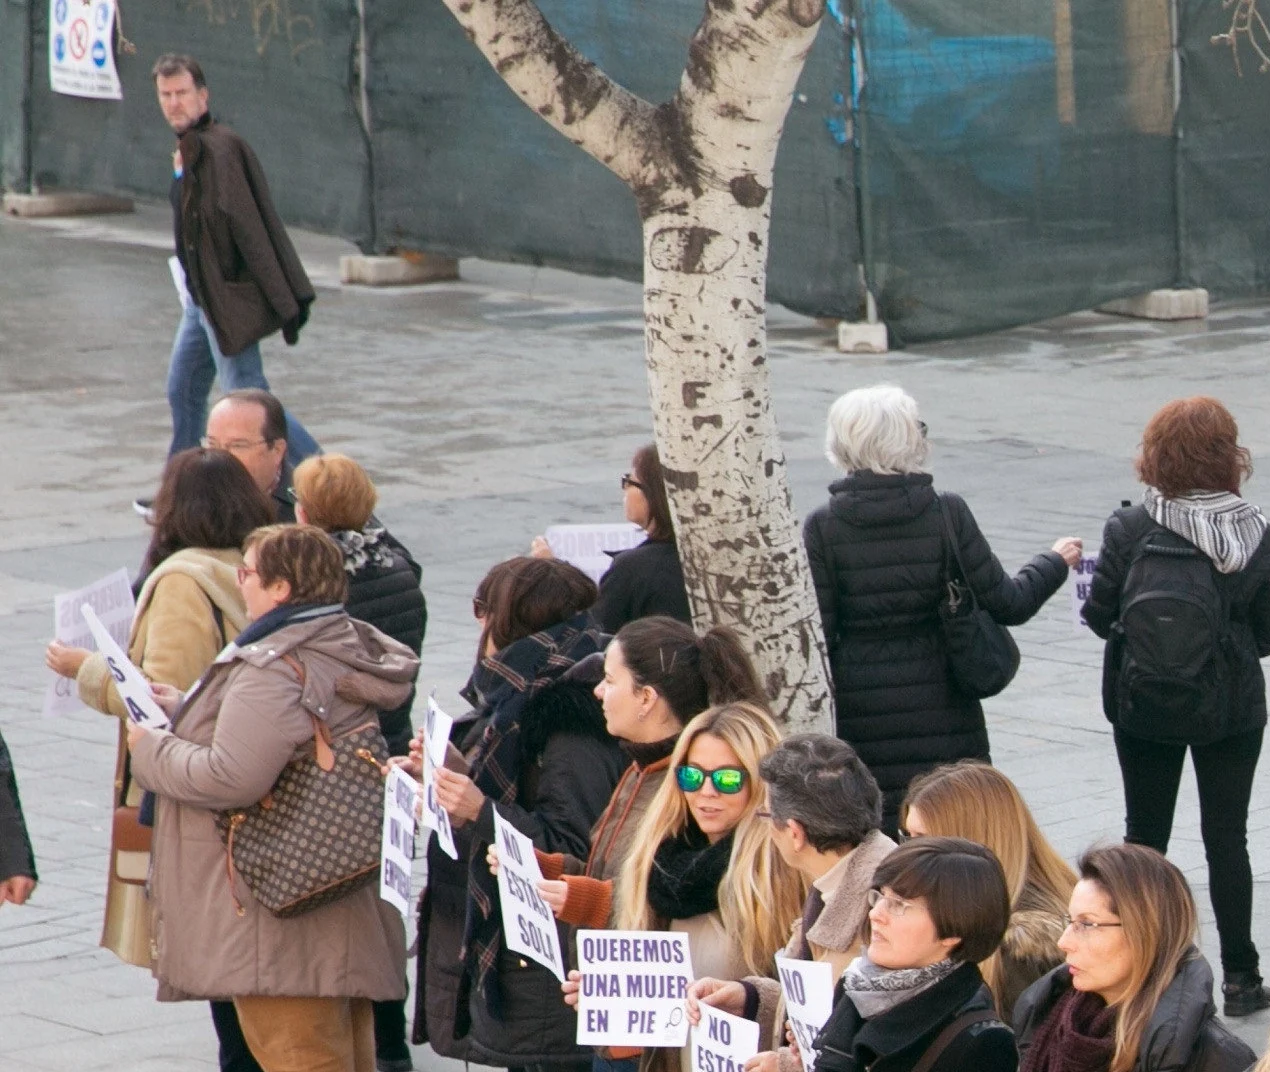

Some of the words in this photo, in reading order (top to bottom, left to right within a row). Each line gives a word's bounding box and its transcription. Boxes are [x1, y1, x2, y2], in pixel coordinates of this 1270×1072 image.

[501, 827, 523, 867] NO
[518, 913, 557, 968] SOLA
[583, 938, 684, 963] QUEREMOS
[583, 974, 621, 997] UNA
[627, 975, 688, 999] MUJER
[781, 967, 806, 1006] NO
[587, 1009, 608, 1032] EN
[628, 1010, 656, 1034] PIE
[709, 1014, 731, 1046] NO
